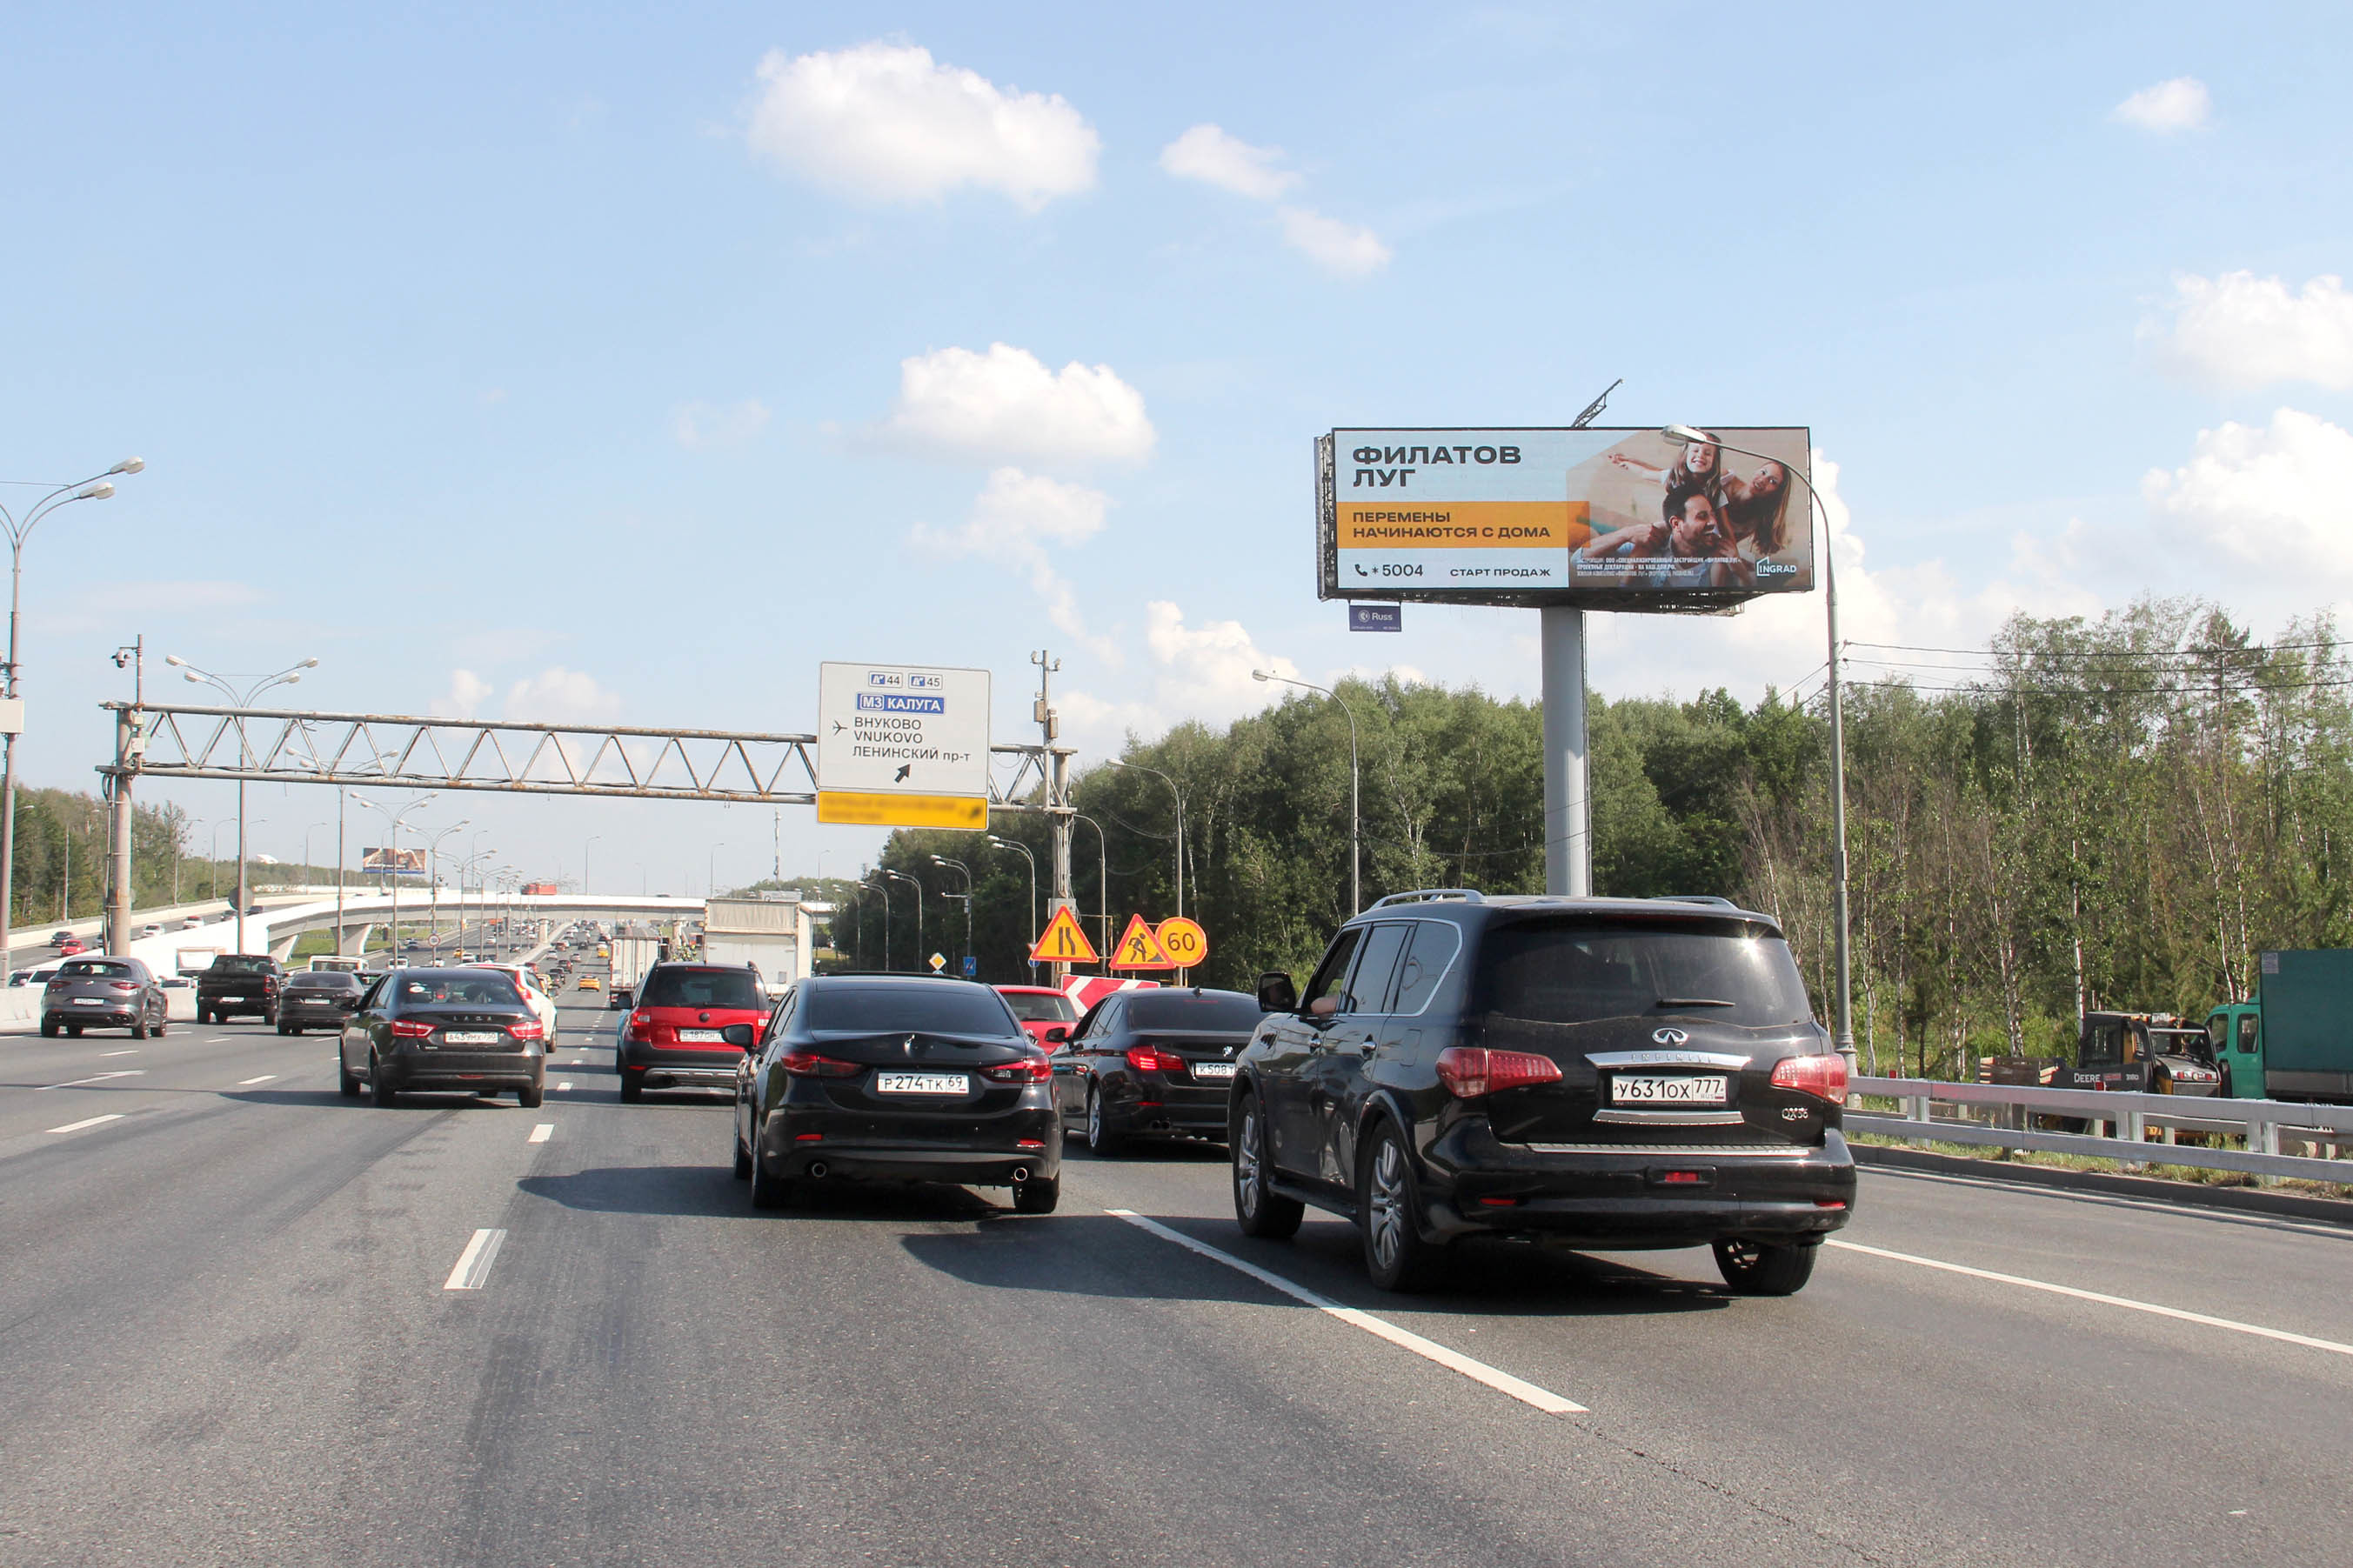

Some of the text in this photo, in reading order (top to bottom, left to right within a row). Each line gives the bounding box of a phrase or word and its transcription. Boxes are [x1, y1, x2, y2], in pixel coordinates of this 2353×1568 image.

[1353, 446, 1521, 464] ФИЛАТОВ
[1353, 469, 1416, 487] ЛУГ
[1353, 512, 1450, 523] ПЕРЕМЕНЫ
[1354, 527, 1551, 539] НАЧИНАЮТСЯ С ДОМА
[1494, 569, 1551, 577] ПРОДАЖ
[1759, 564, 1797, 574] INGRAD
[1372, 612, 1393, 621] Russ
[886, 676, 900, 684] 44
[926, 677, 940, 687] 45
[887, 697, 941, 711] КАЛУГА
[854, 717, 922, 731] ВНУКОВО
[854, 731, 923, 744] VNUKOVO
[852, 746, 971, 763] ЛЕНИНСКИЙ пр-т
[1167, 932, 1195, 951] 60
[2074, 1072, 2101, 1083] DEERE
